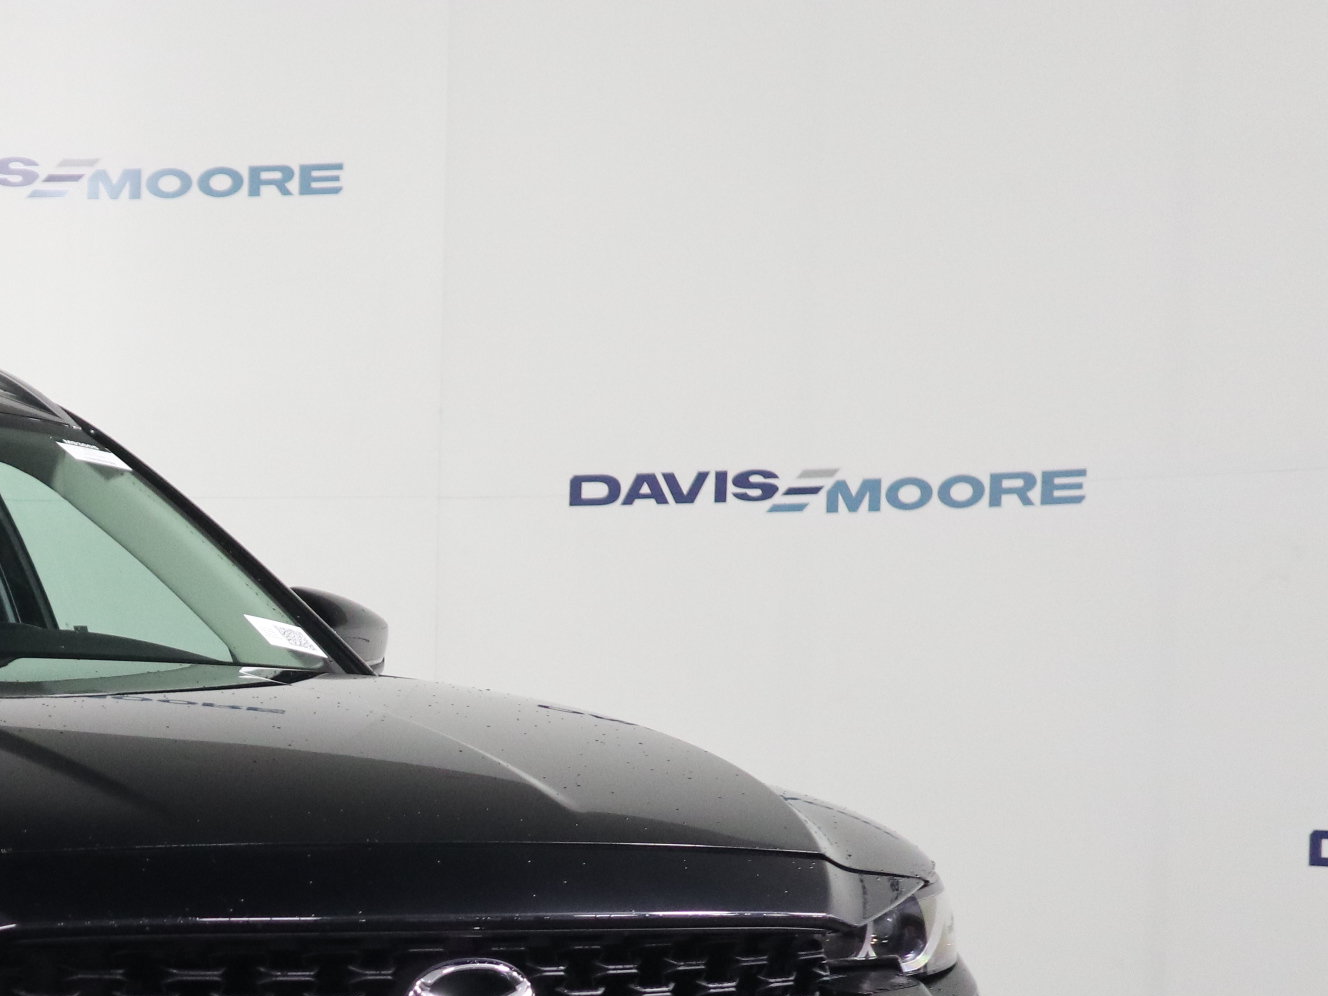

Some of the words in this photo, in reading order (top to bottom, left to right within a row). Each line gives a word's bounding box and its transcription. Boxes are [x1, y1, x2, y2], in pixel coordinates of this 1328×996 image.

[86, 162, 344, 200] MOORE
[568, 469, 780, 507] DAVIS
[826, 468, 1087, 514] MOORE
